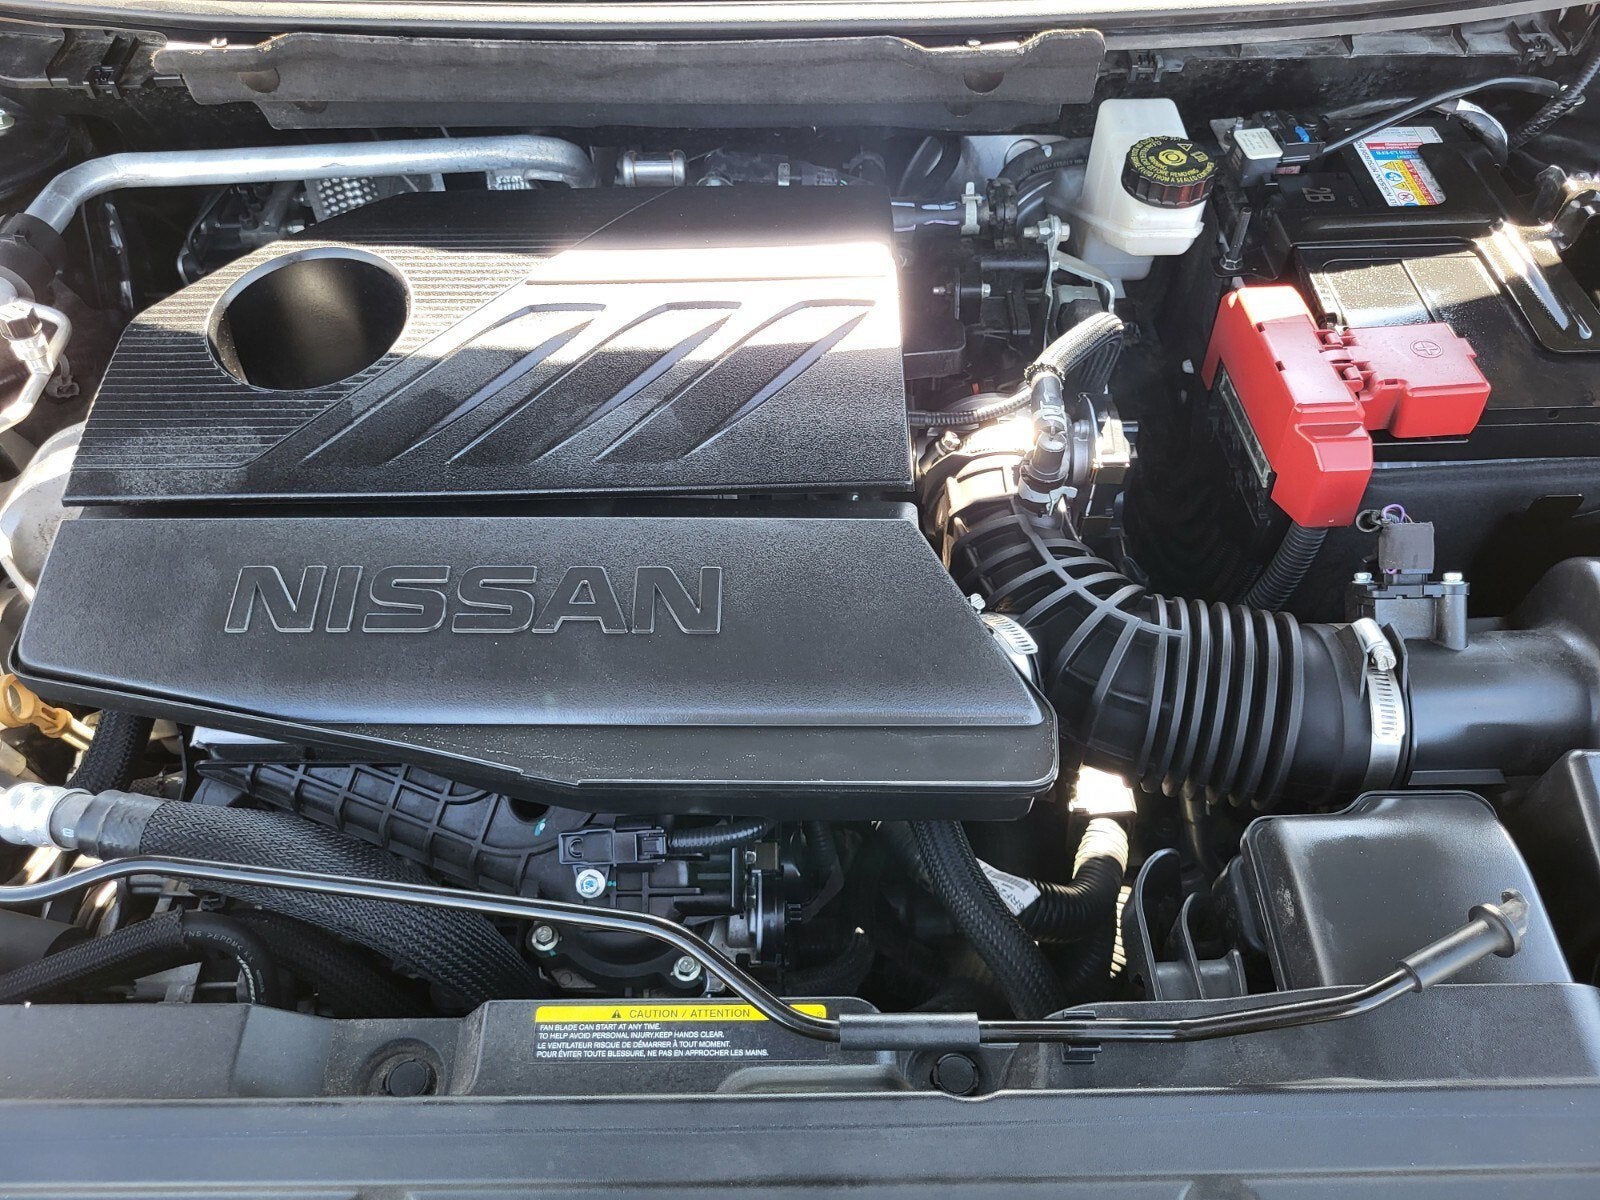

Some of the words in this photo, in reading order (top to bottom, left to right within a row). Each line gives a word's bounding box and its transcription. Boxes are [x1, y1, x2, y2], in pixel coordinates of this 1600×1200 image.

[1153, 173, 1170, 182] FROM
[1176, 175, 1198, 183] SEALED
[1302, 187, 1336, 202] 2B
[225, 565, 722, 634] NISSAN
[630, 1010, 678, 1018] CAUTION
[690, 1009, 750, 1018] ATTENTION
[632, 1040, 671, 1048] DÉMARRER
[558, 1048, 582, 1058] ÉVITER
[608, 1050, 646, 1058] BLESSURE,
